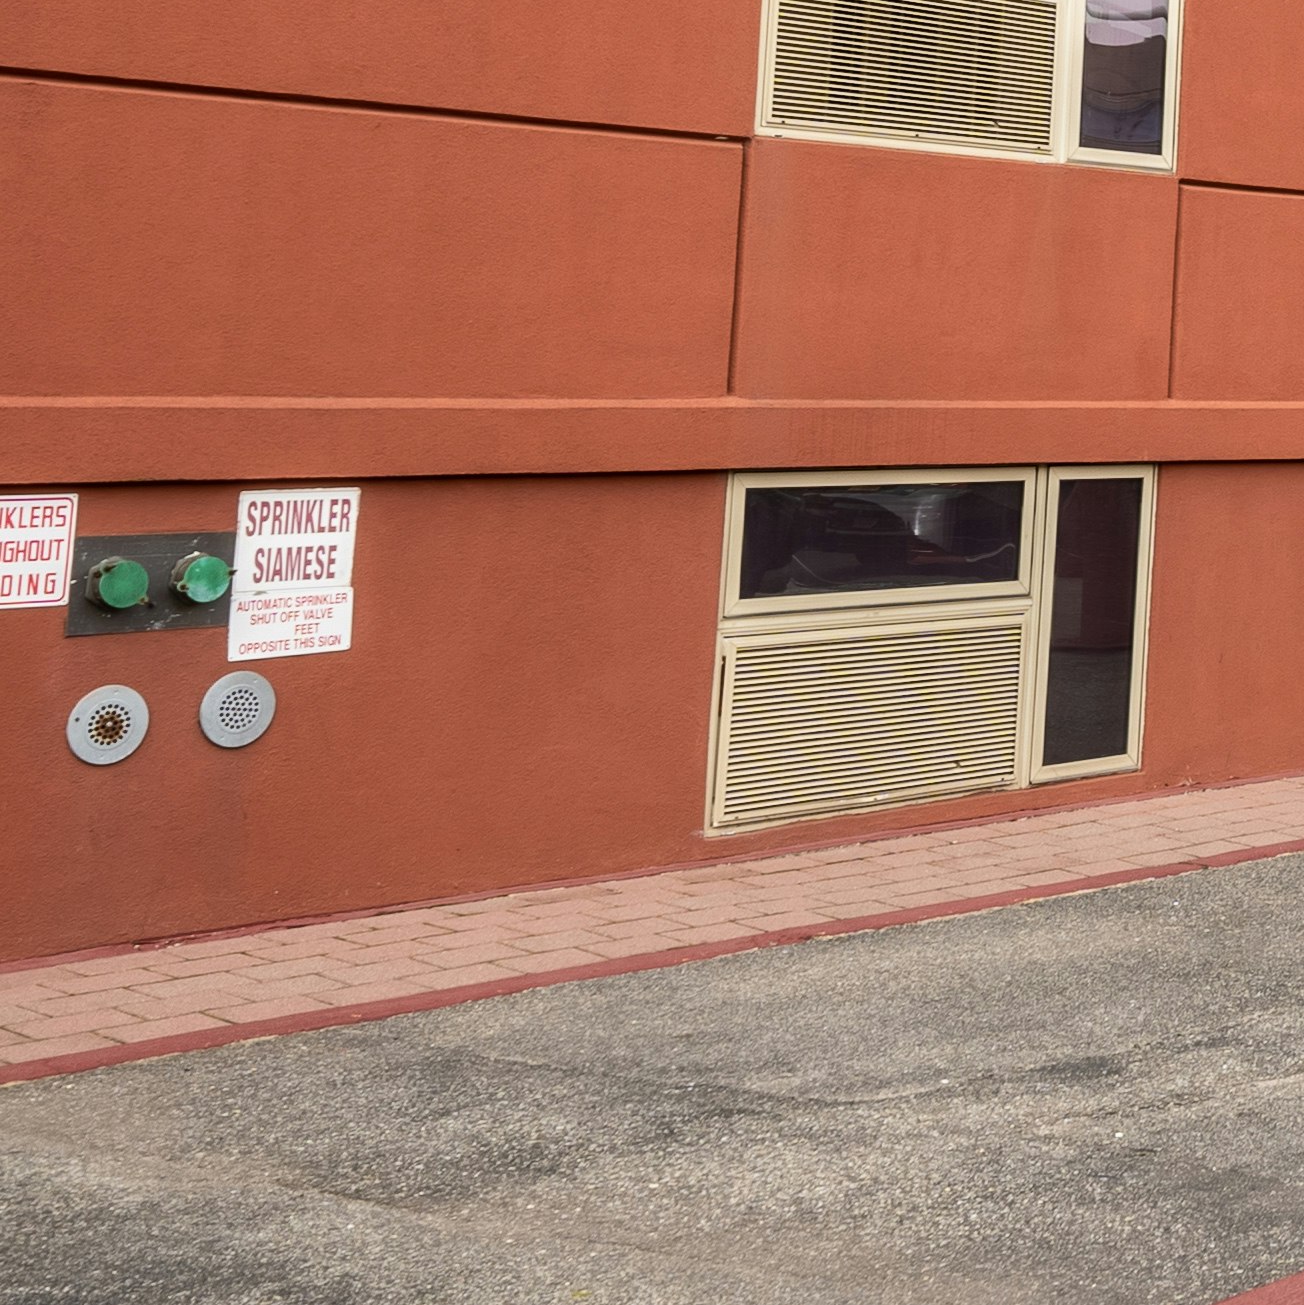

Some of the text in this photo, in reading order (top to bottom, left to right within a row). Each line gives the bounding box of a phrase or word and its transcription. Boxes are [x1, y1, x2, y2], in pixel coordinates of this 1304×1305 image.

[246, 499, 351, 537] SPRINKLER
[253, 545, 337, 583] SIAMESE
[1, 573, 56, 596] DING
[237, 593, 347, 612] AUTOMATIC SPRINKLER
[250, 608, 333, 625] SHUT OFF VALVE
[294, 623, 320, 635] FEET
[239, 635, 341, 655] OPPOSITE THIS SIGN
